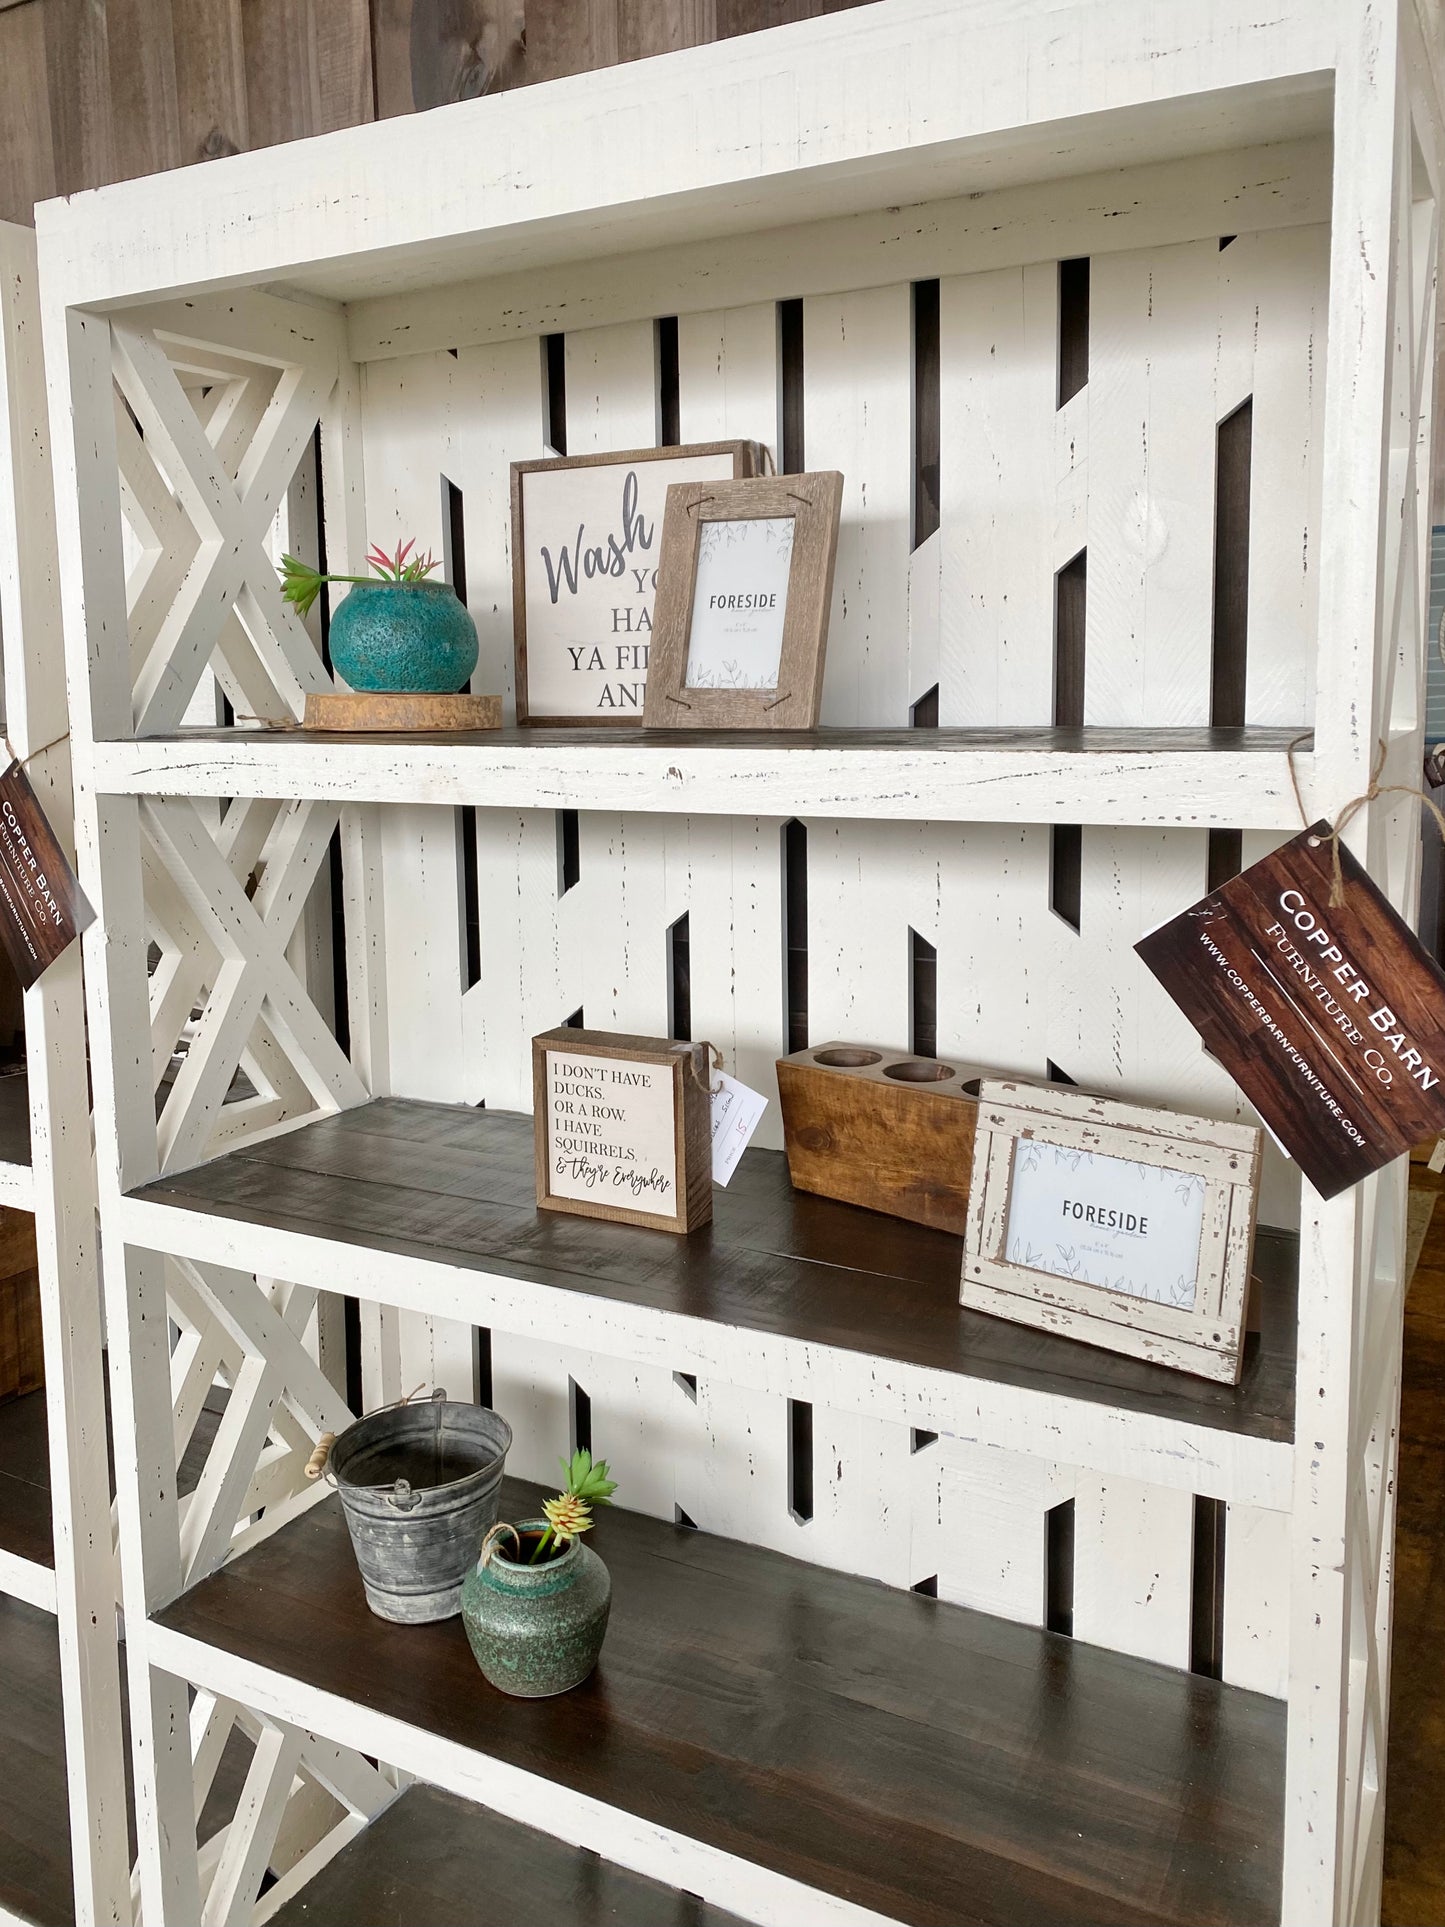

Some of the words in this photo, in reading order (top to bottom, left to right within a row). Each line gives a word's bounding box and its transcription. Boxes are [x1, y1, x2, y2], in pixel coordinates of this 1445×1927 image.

[541, 471, 654, 604] Wash
[709, 593, 777, 609] FORESIDE
[567, 646, 607, 671] YA
[597, 683, 647, 708] AN
[2, 801, 38, 873] COPPER
[35, 873, 64, 927] BARN
[34, 900, 47, 926] CO.
[1279, 889, 1371, 1004] COPPER
[1367, 1005, 1441, 1092] BARN
[1264, 920, 1365, 1047] FURNITURE
[1362, 1048, 1394, 1091] CO.
[1199, 932, 1367, 1148] WWW.COPPERBARNFURNITURE.COM
[553, 1062, 559, 1076] I
[562, 1063, 609, 1082] DON'T
[611, 1070, 653, 1089] HAVE
[554, 1081, 606, 1101] DUCKS.
[554, 1099, 575, 1115] OR
[578, 1103, 588, 1117] A
[591, 1104, 627, 1123] ROW.
[555, 1118, 560, 1131] I
[564, 1119, 603, 1137] HAVE
[555, 1136, 638, 1162] SQUIRRELS.
[556, 1156, 567, 1174] &
[1062, 1199, 1149, 1235] FORESIDE
